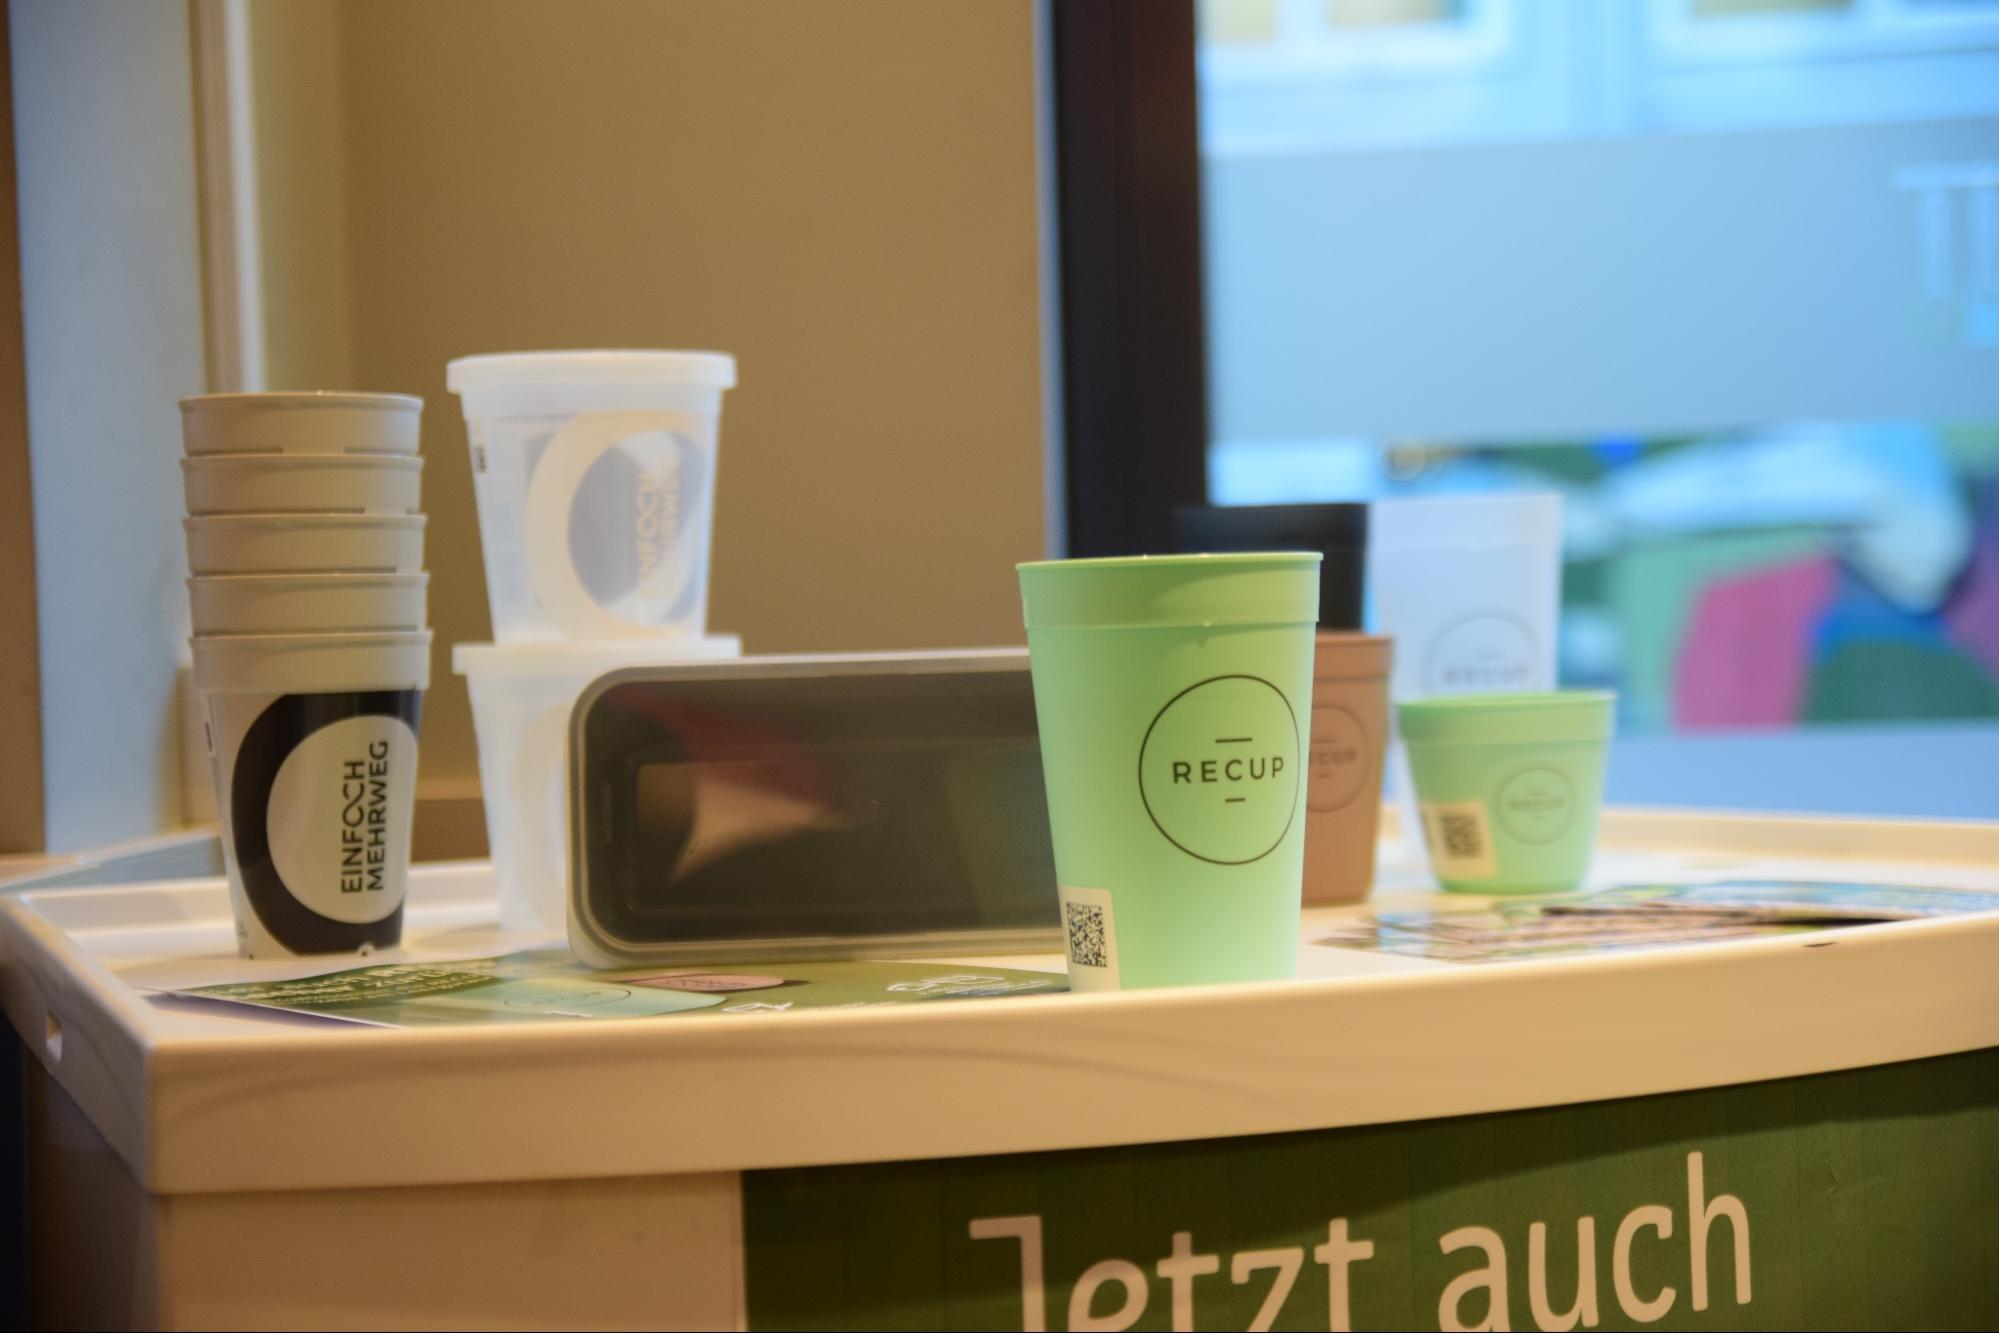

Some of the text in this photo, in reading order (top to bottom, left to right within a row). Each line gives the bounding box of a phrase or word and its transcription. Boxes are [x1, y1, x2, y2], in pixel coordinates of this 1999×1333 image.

[367, 741, 389, 891] MEHRWEG
[1172, 756, 1285, 784] RECUP
[969, 1152, 1752, 1332] Jetzt auch
